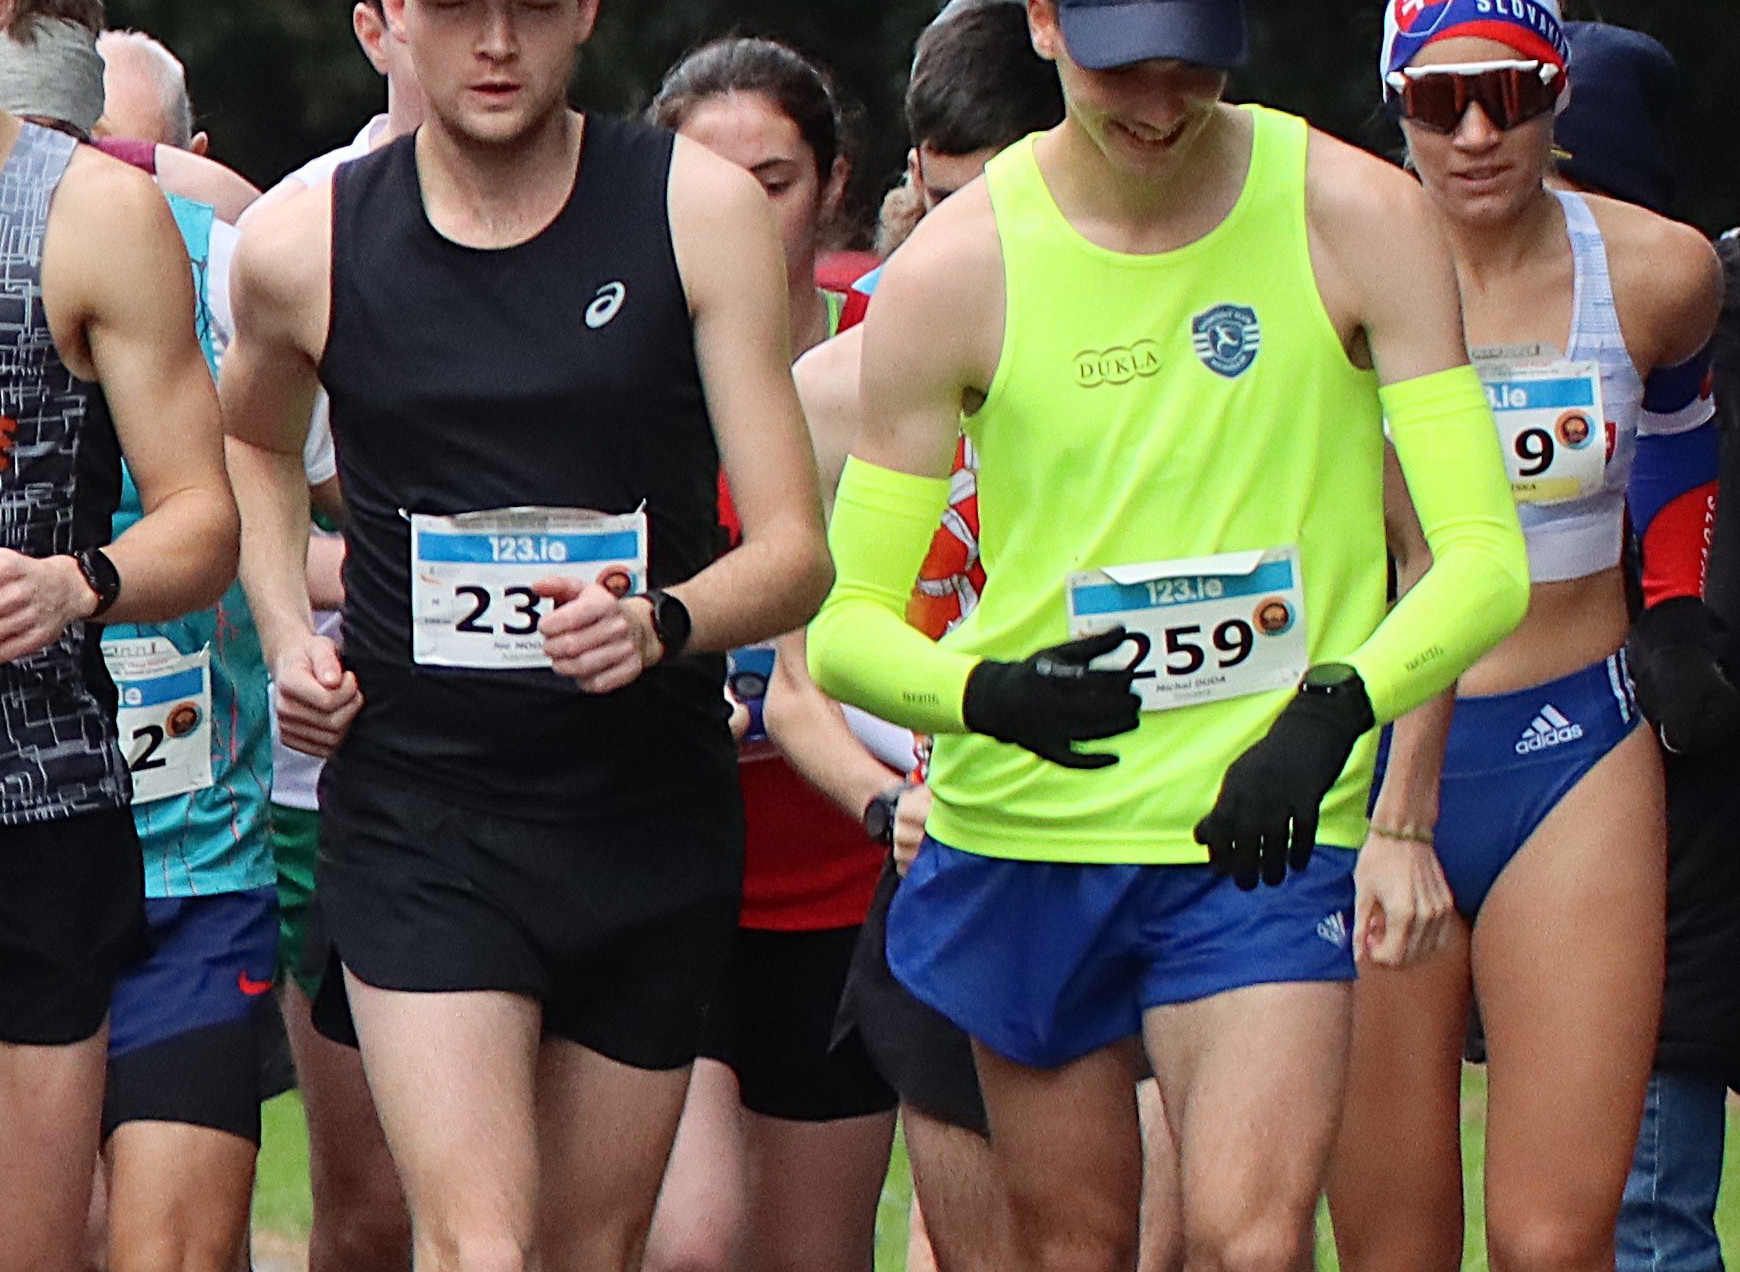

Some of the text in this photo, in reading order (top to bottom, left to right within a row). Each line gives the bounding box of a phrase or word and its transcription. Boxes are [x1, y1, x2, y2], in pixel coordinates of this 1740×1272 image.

[1080, 350, 1158, 378] DUKLA
[488, 536, 567, 562] 123.ie
[1145, 576, 1224, 605] 123.ie
[454, 585, 550, 636] 23
[1124, 618, 1255, 679] 259
[1514, 723, 1584, 756] adidas
